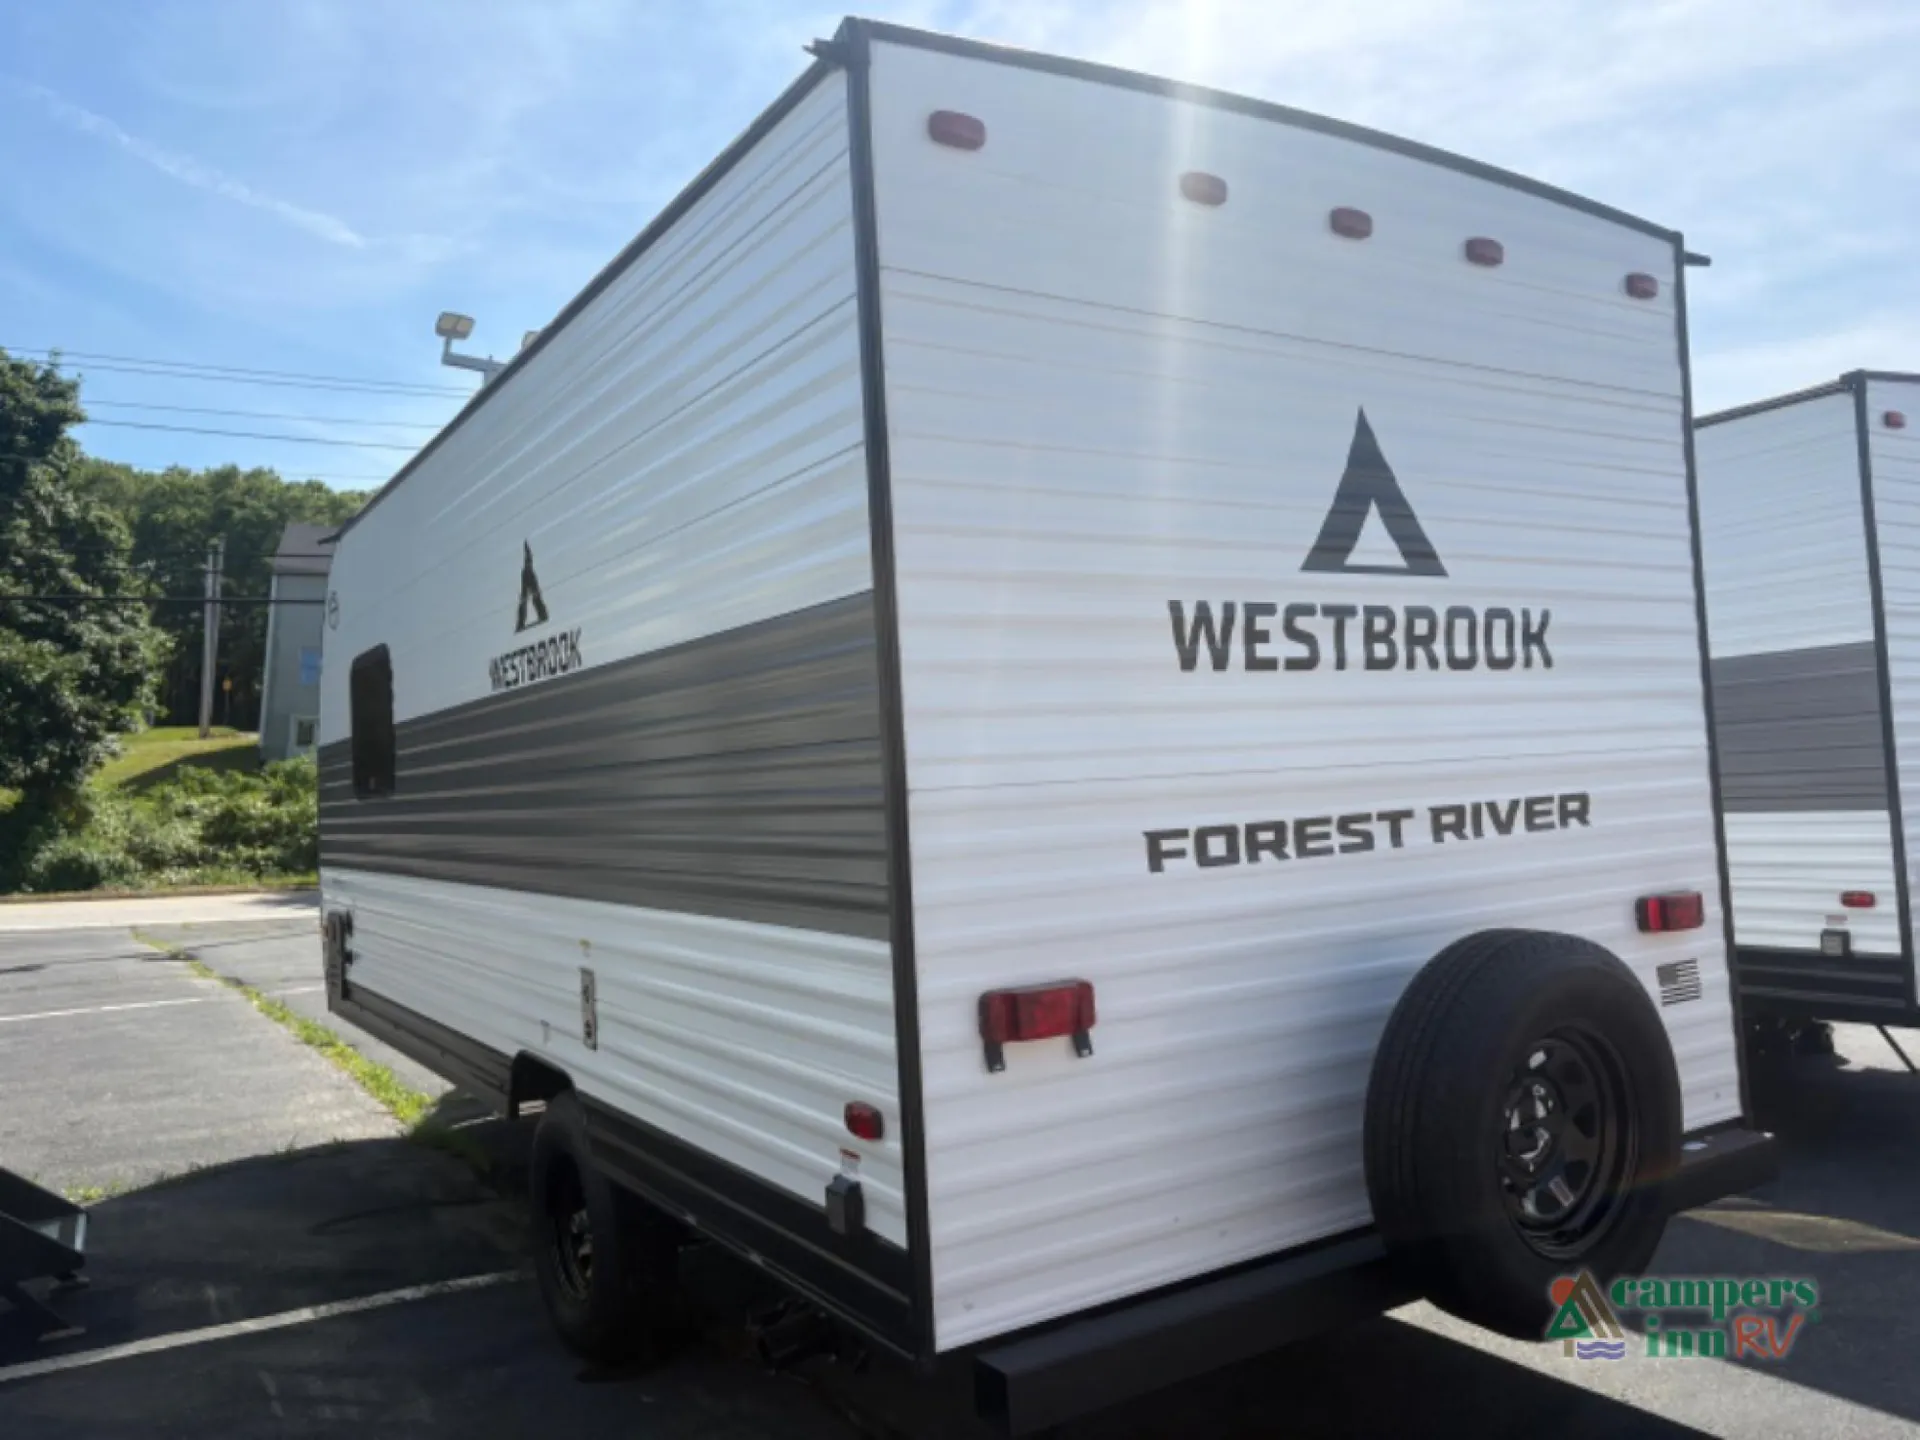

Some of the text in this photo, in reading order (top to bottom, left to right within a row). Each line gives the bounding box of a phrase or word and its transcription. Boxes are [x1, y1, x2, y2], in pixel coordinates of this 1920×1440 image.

[489, 628, 582, 691] WESTBROOK
[1168, 600, 1553, 672] WESTBROOK
[1143, 791, 1591, 873] FOREST RIVER
